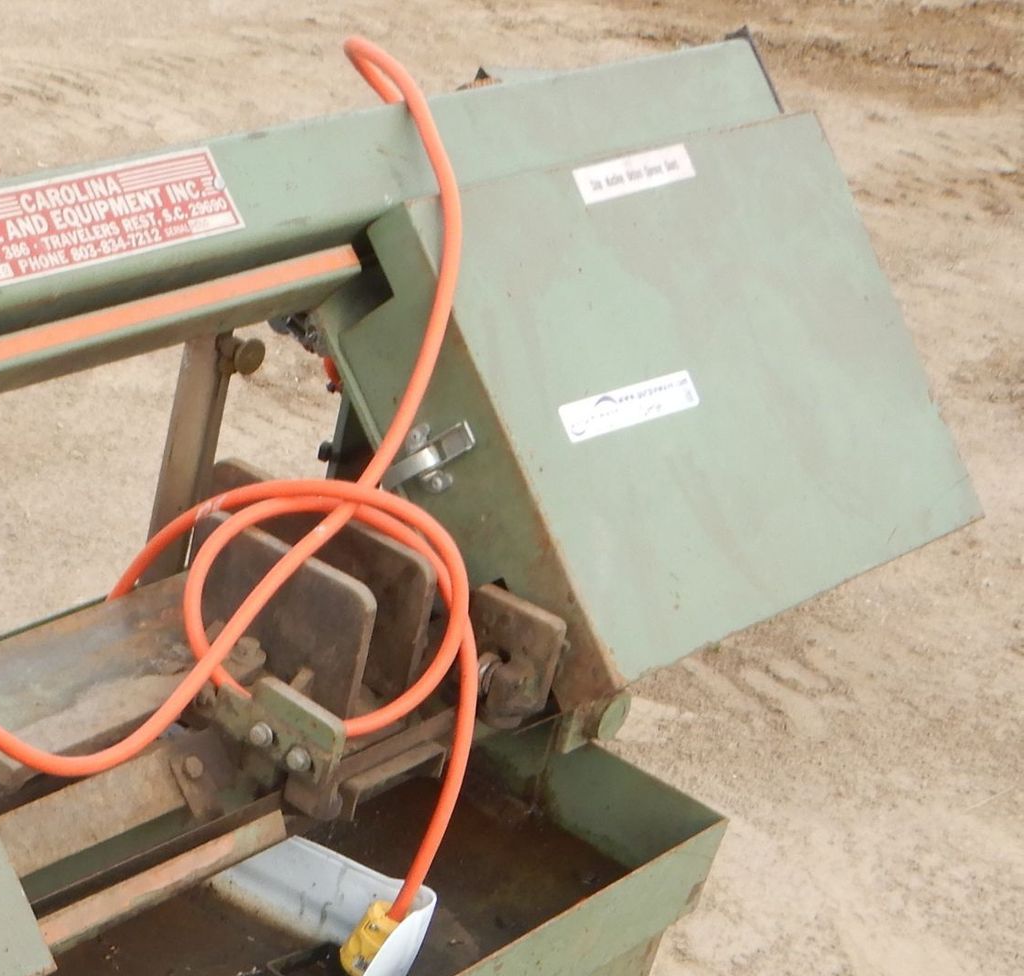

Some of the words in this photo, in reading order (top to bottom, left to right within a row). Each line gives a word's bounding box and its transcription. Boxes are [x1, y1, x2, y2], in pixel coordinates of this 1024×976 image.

[5, 214, 49, 241] AND
[49, 187, 164, 230] EQUIPMENT
[165, 179, 207, 201] INC.
[20, 175, 122, 213] CAROLINA
[17, 249, 69, 274] PHONE
[71, 228, 162, 262] 803-834-7212
[40, 221, 121, 251] TRAVELERS
[121, 211, 162, 232] REST,
[162, 205, 189, 223] S.C.
